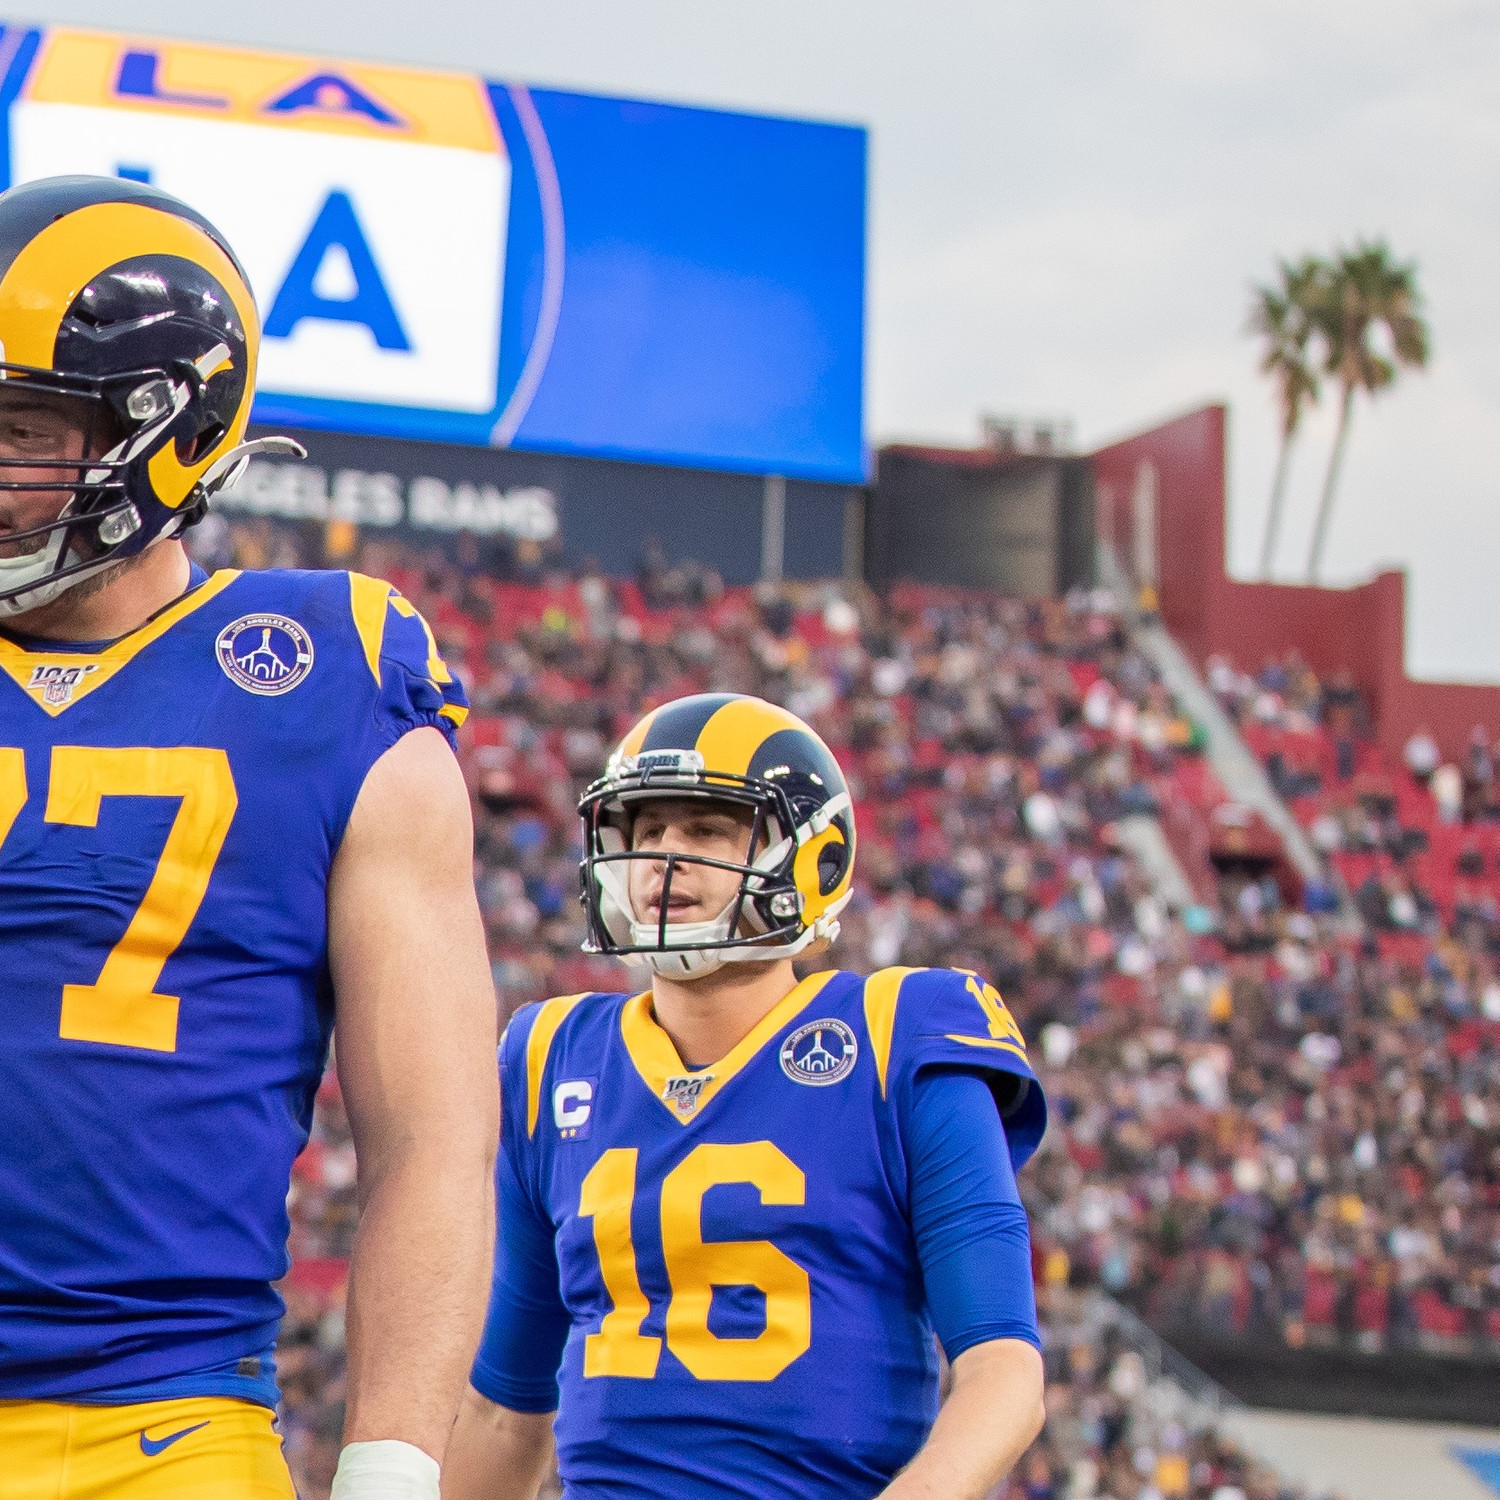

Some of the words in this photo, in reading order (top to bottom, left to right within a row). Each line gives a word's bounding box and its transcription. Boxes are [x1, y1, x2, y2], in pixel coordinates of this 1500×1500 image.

[116, 51, 407, 128] LA
[554, 1081, 592, 1128] C
[577, 1140, 811, 1381] 16
